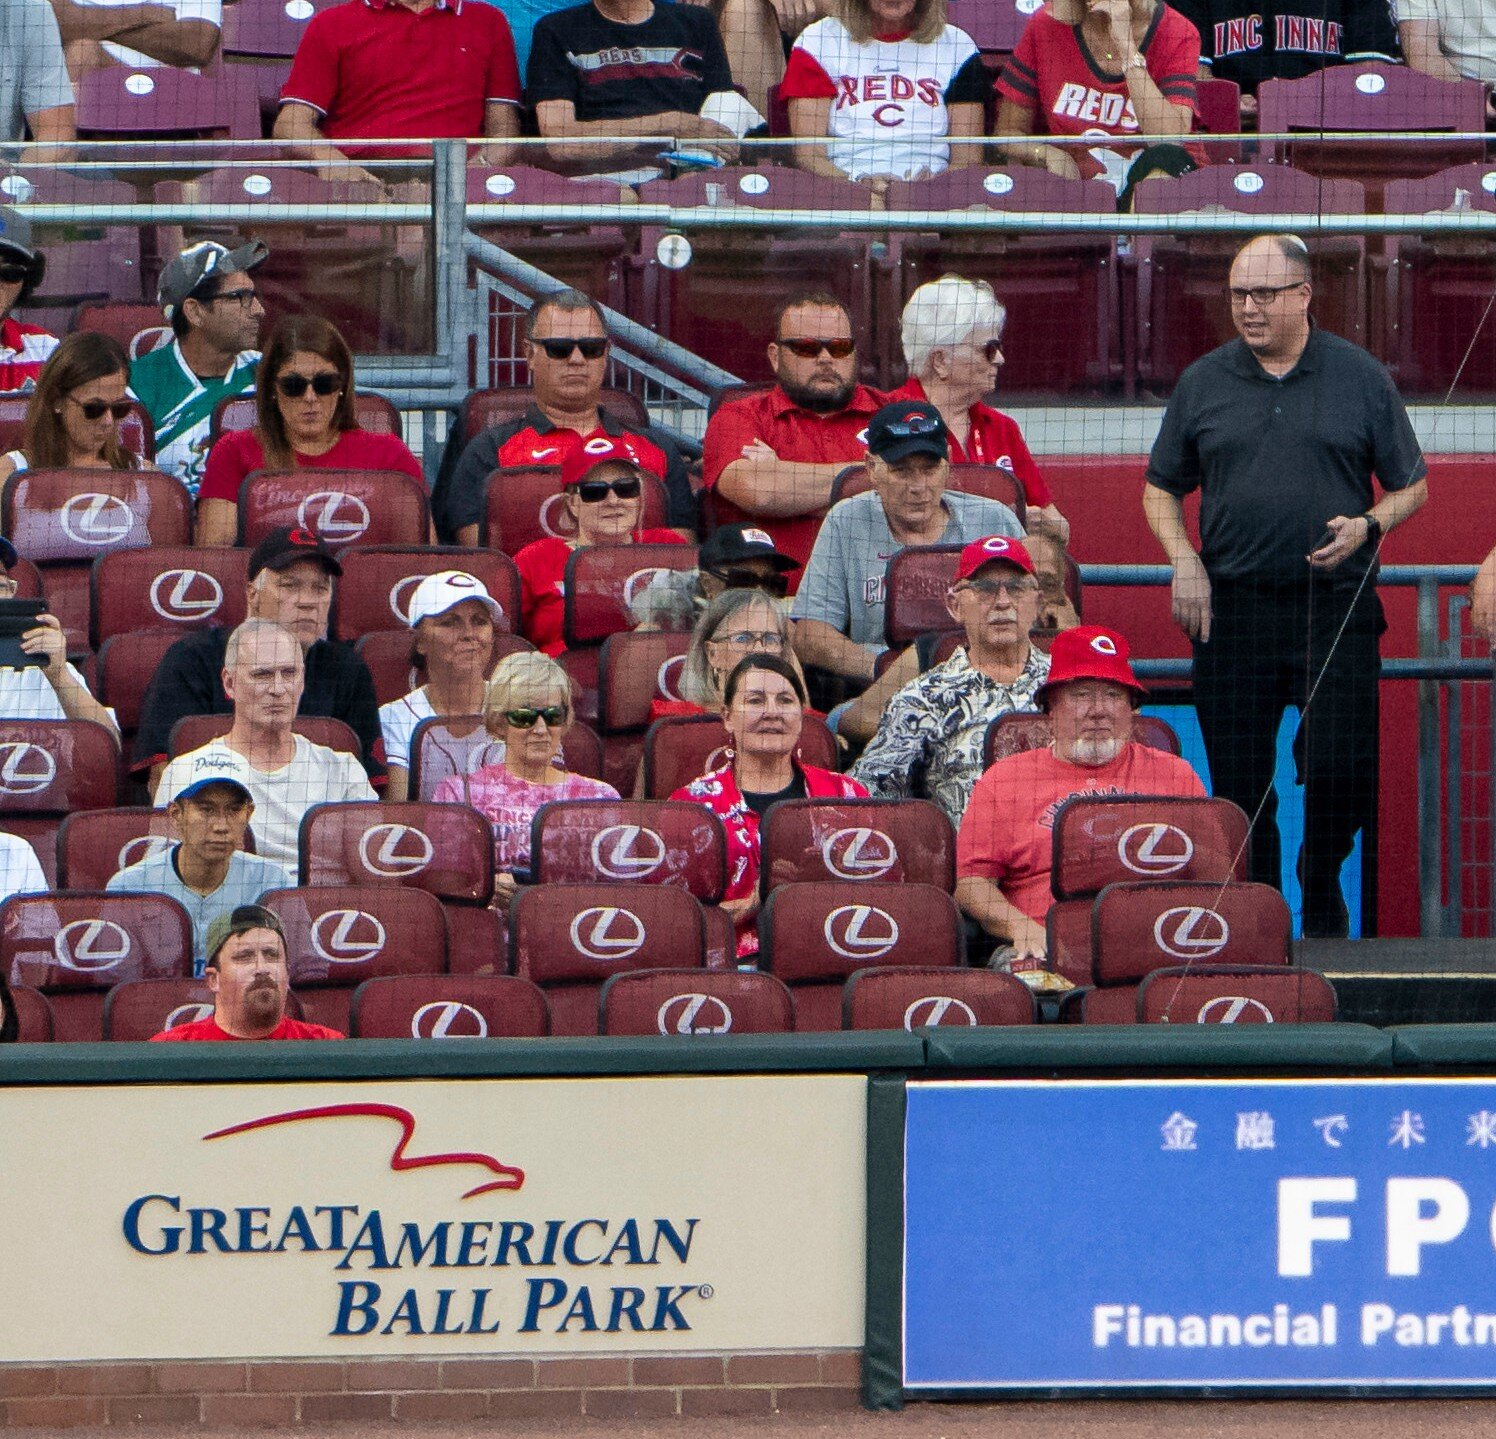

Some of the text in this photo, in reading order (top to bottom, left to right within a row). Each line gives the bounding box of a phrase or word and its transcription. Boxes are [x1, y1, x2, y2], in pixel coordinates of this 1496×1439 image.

[834, 73, 940, 112] REDS
[871, 102, 906, 127] C
[1053, 81, 1141, 130] REDS
[583, 437, 614, 455] C
[288, 528, 318, 546] C
[982, 537, 1010, 550] C
[445, 573, 478, 587] C
[1089, 635, 1117, 655] C
[123, 1195, 700, 1269] GREAT AMERICAN
[329, 1278, 502, 1337] BALL
[1093, 1303, 1337, 1348] Financial
